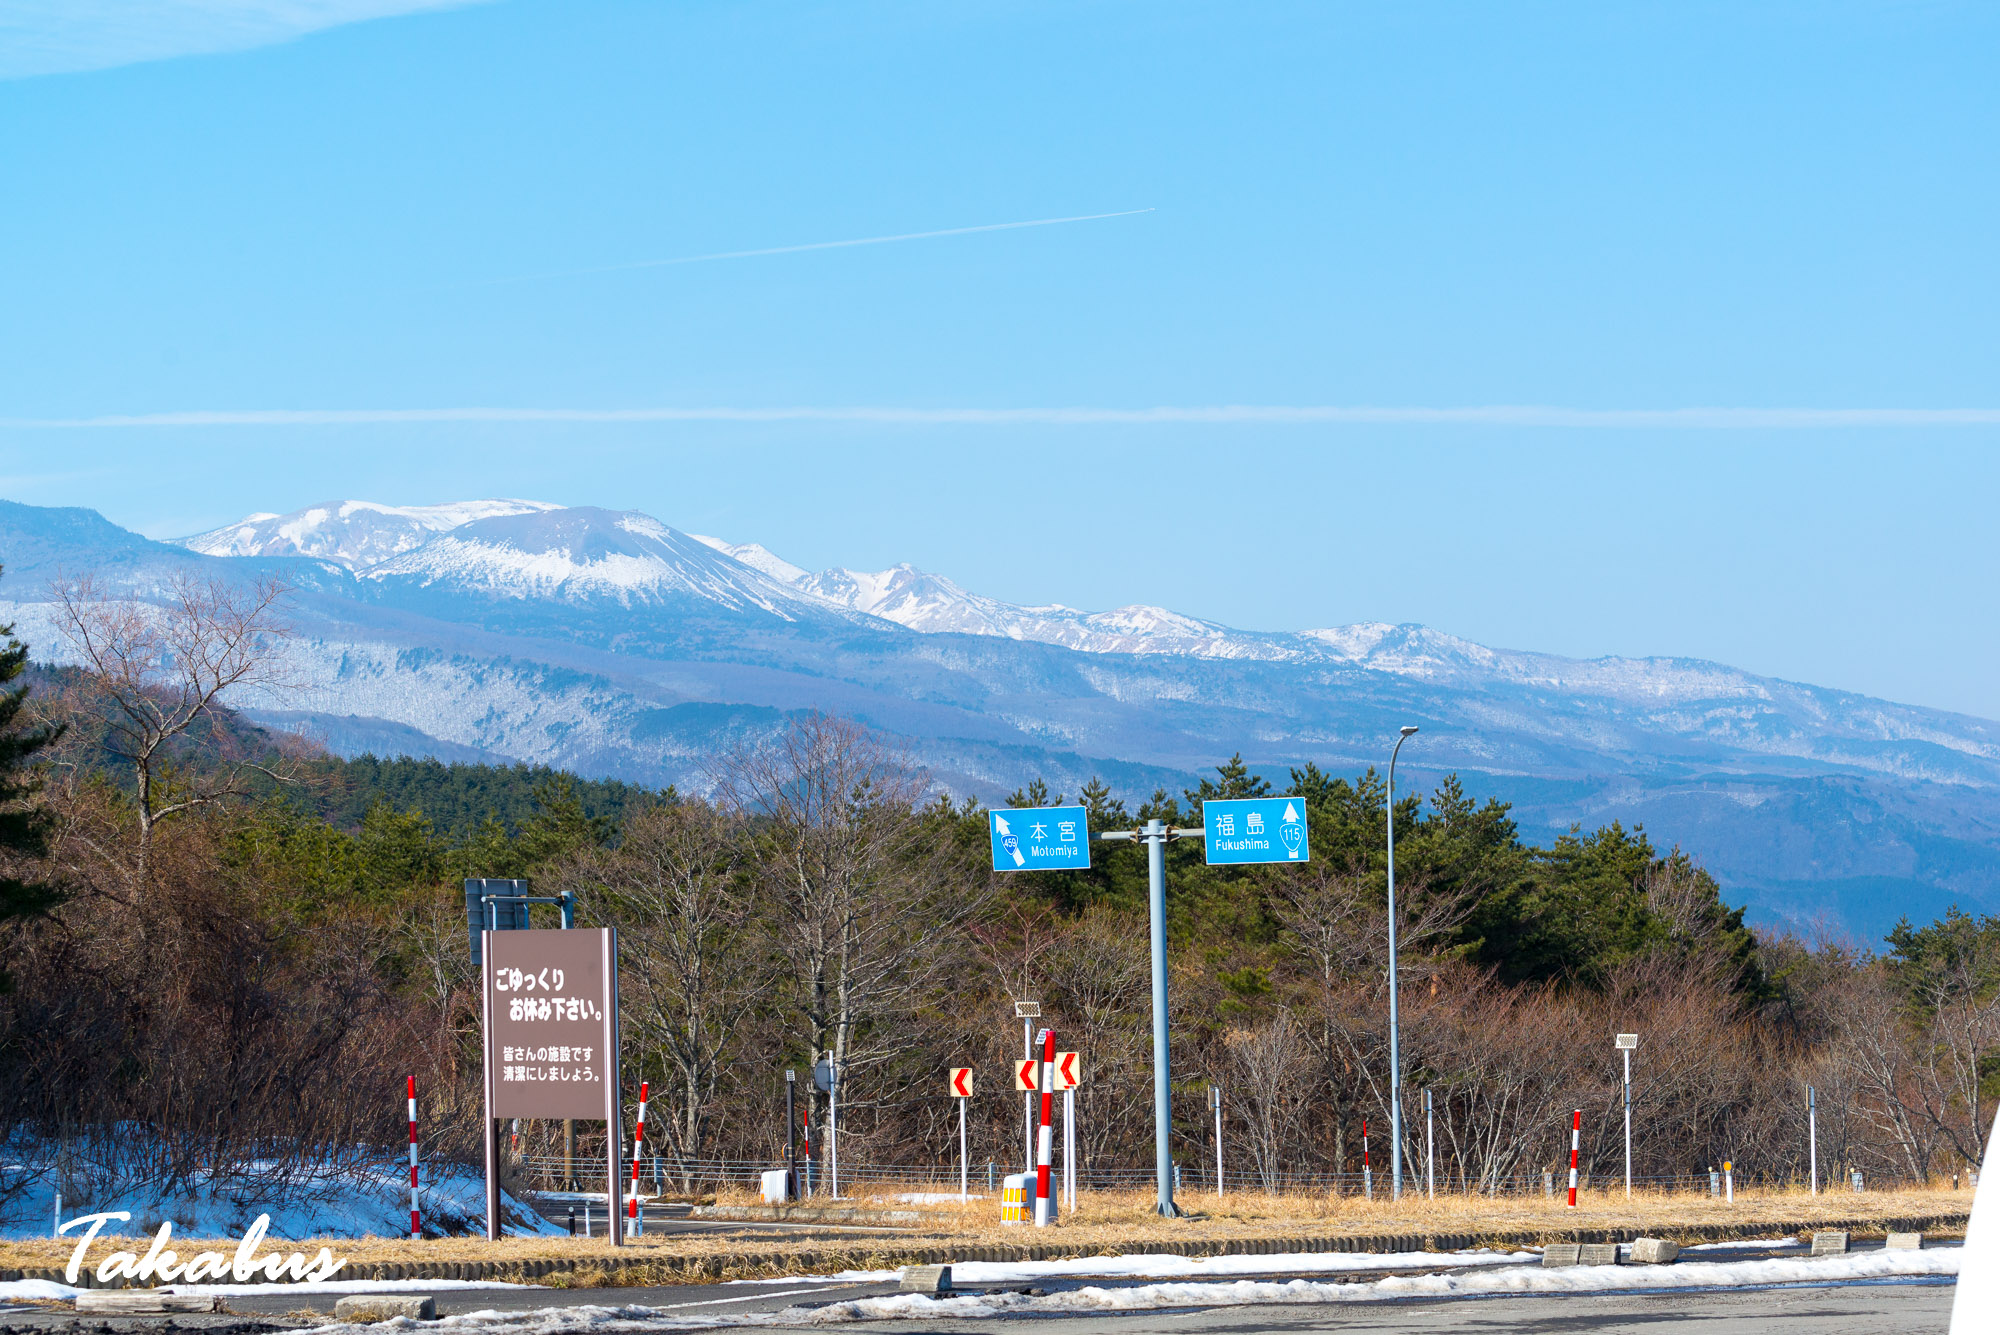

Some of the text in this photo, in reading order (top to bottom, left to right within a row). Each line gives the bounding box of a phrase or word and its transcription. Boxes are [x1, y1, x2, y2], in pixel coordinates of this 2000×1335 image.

[1029, 820, 1076, 843] 本宮
[1215, 811, 1264, 836] 福島
[1004, 837, 1017, 848] 459
[1283, 827, 1300, 841] 115
[1031, 844, 1078, 859] Motomiya
[1215, 838, 1270, 851] Fukushima
[496, 967, 564, 992] ごゆっくり
[509, 996, 602, 1021] お休み下さい。
[503, 1045, 593, 1062] 皆さんの施設です
[503, 1065, 600, 1082] 清潔にしましょう。
